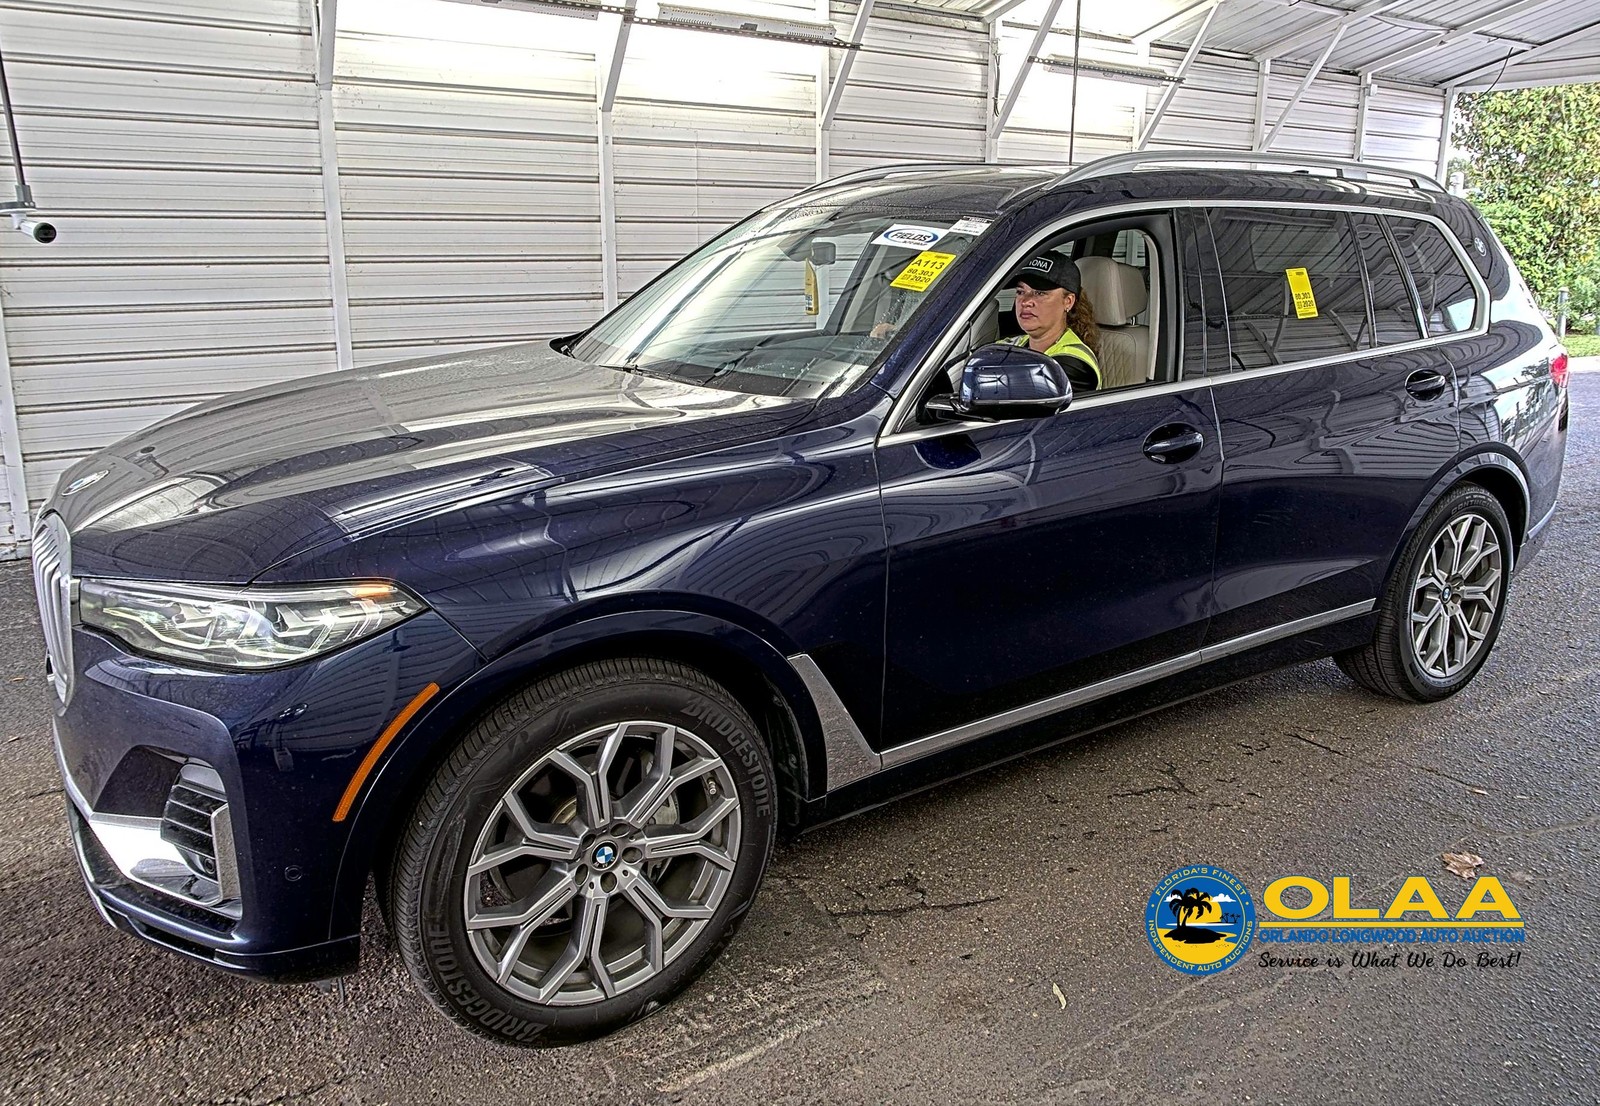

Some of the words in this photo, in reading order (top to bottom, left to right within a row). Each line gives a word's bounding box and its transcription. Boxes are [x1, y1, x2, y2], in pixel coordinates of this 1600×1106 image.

[890, 231, 931, 242] FIELDS
[911, 258, 945, 270] A113
[910, 275, 931, 283] 2020
[680, 696, 771, 818] BRIDGESTONE
[428, 922, 551, 1043] BRIDGESTONE
